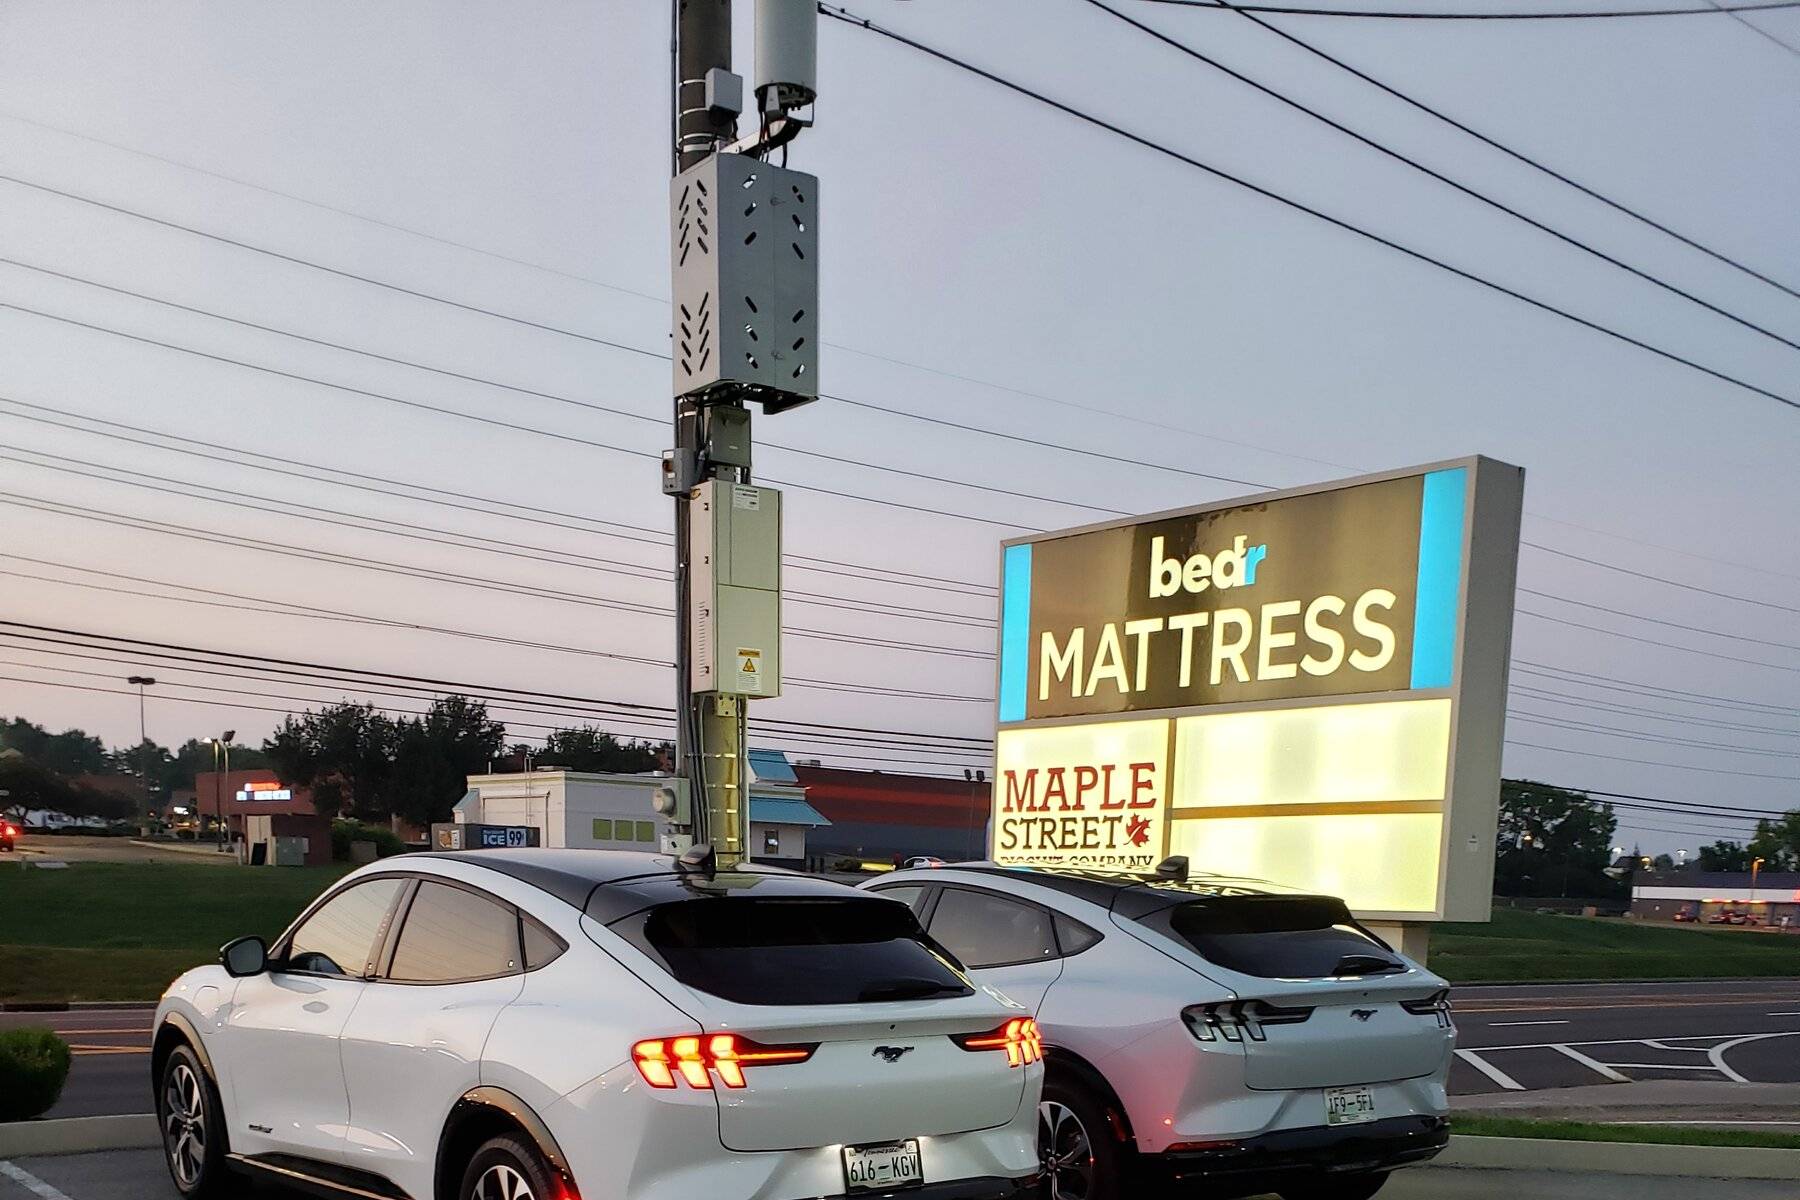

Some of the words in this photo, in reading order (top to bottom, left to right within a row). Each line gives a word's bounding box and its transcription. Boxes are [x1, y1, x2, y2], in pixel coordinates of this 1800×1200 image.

[1039, 588, 1397, 701] MATTRESS
[1002, 762, 1157, 813] MAPLE
[483, 834, 505, 845] ICE
[1000, 816, 1124, 851] STREET
[850, 1155, 917, 1182] 616-KGV
